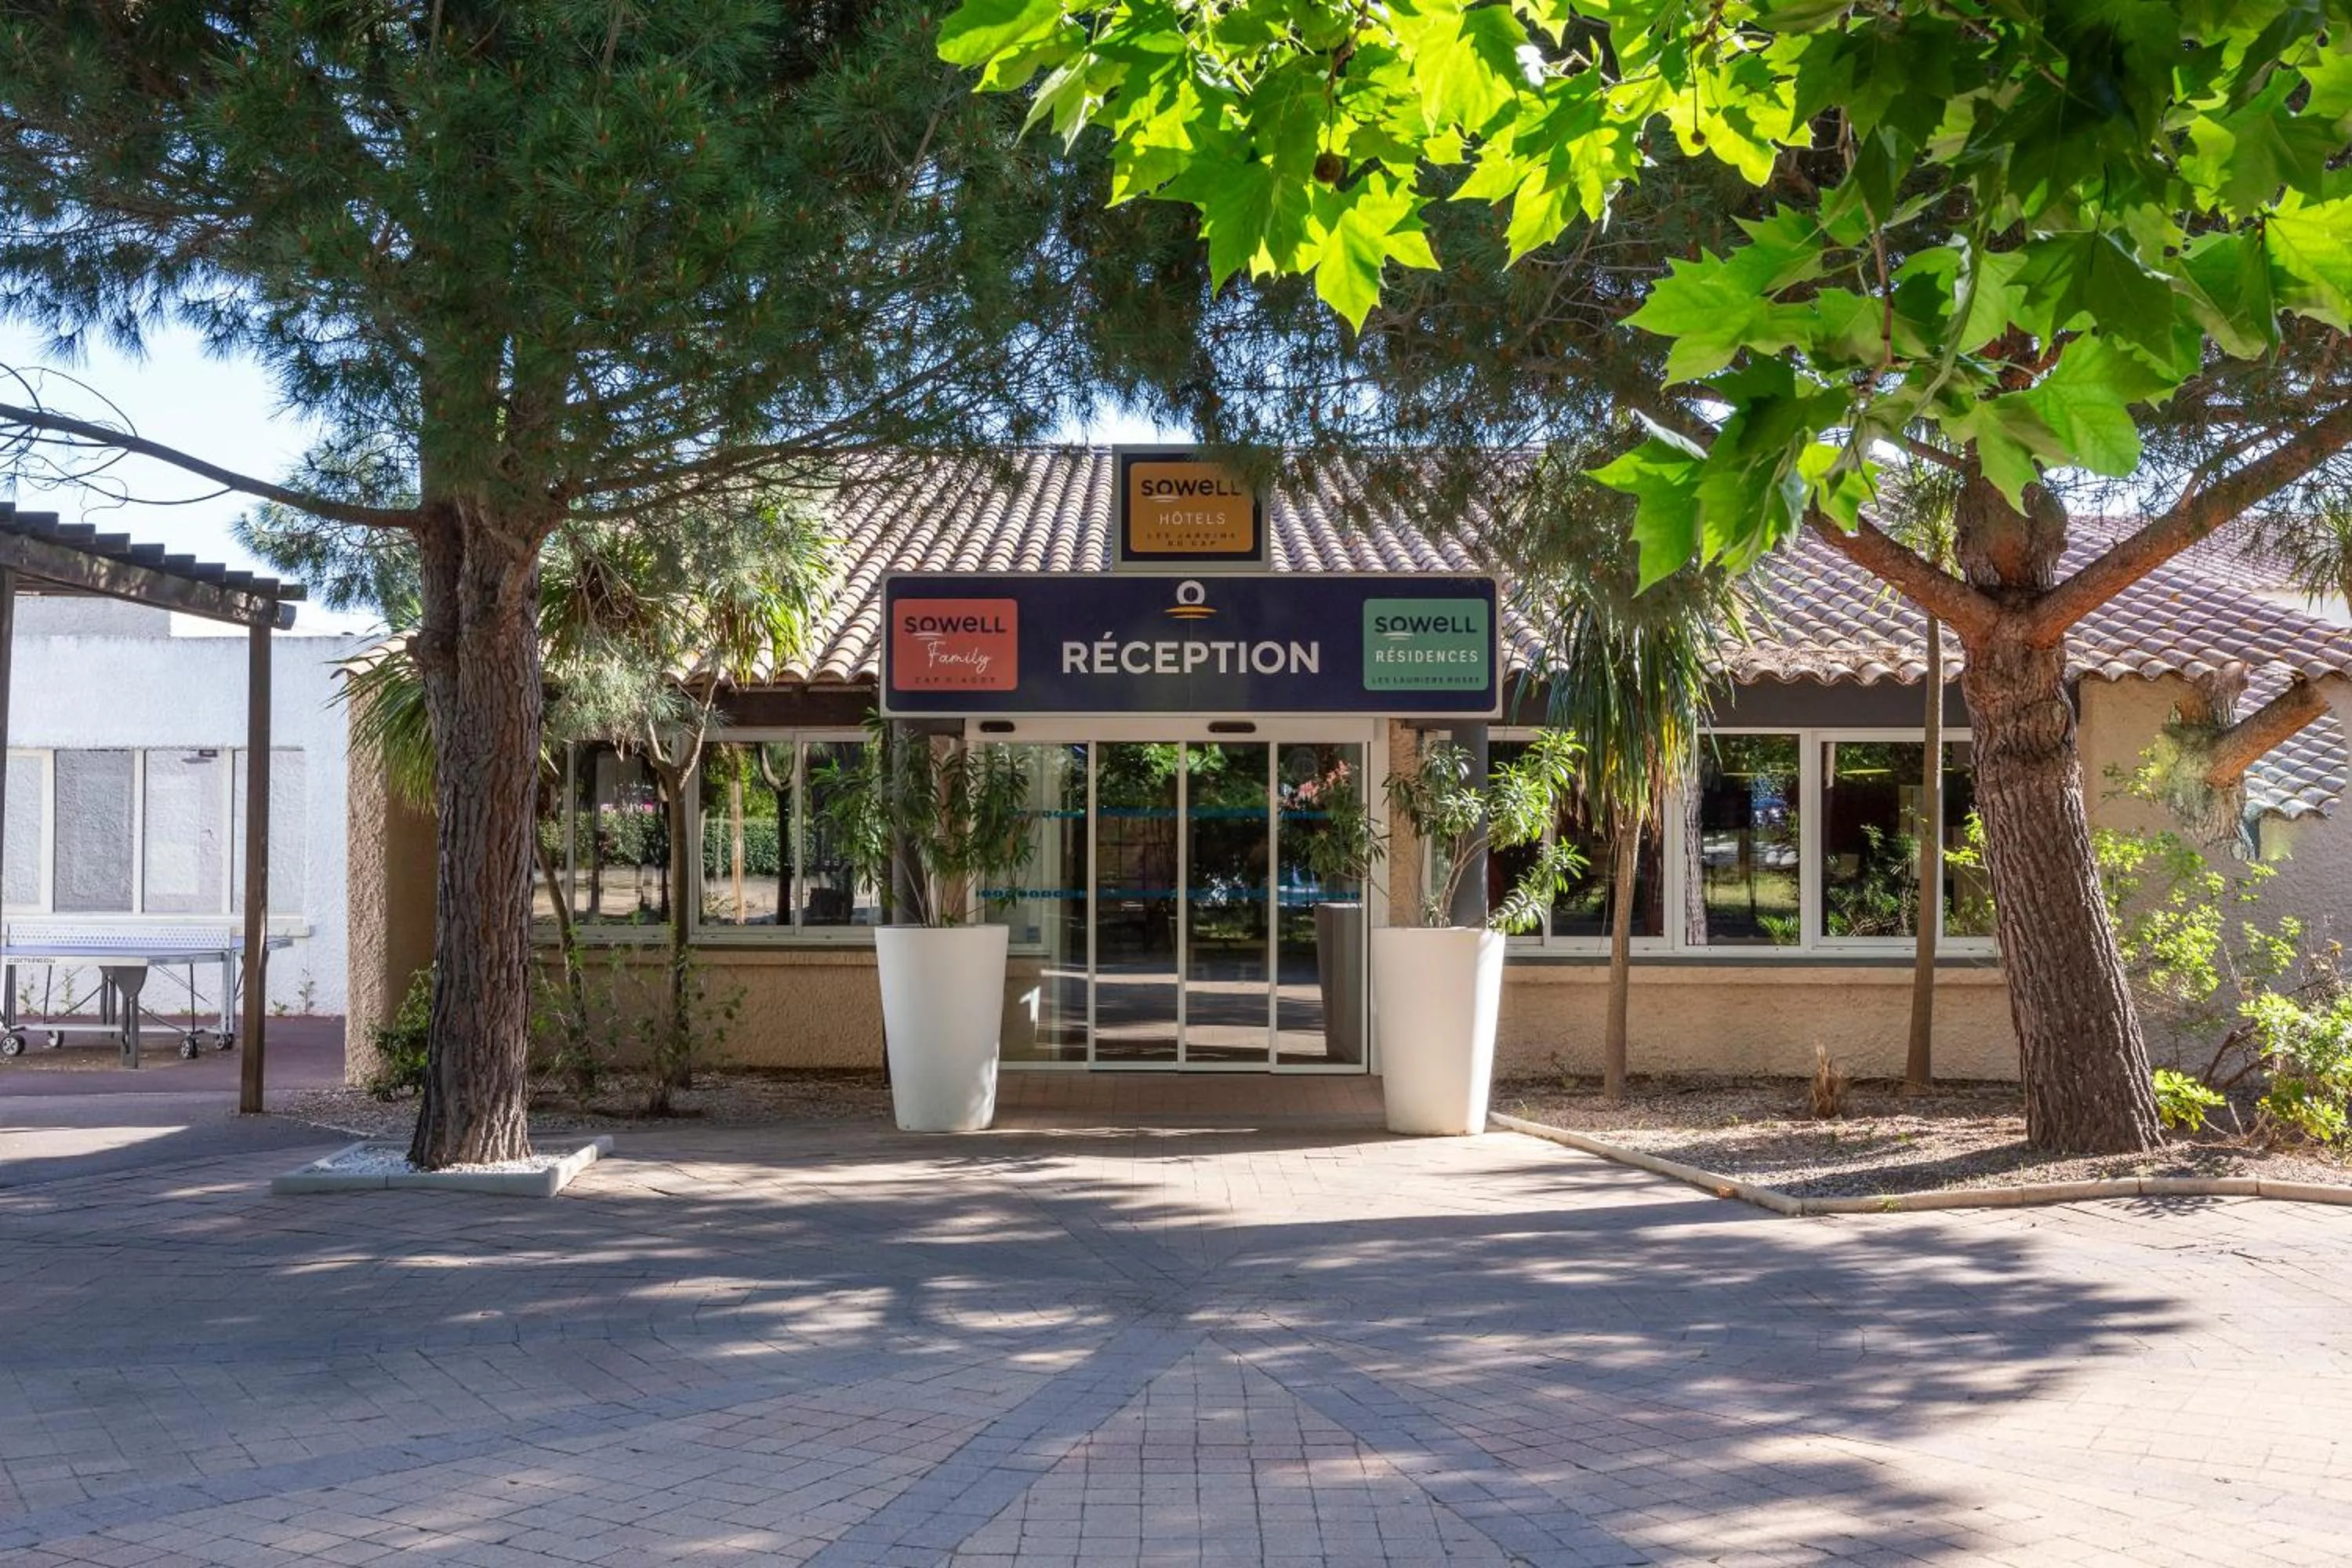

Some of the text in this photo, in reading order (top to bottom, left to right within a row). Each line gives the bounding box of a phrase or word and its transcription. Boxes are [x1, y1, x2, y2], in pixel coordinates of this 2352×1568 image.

[1160, 511, 1226, 525] HÔTELS
[927, 641, 993, 674] Family
[1062, 631, 1319, 674] RÉCEPTION
[1375, 645, 1479, 662] RÉSIDENCES
